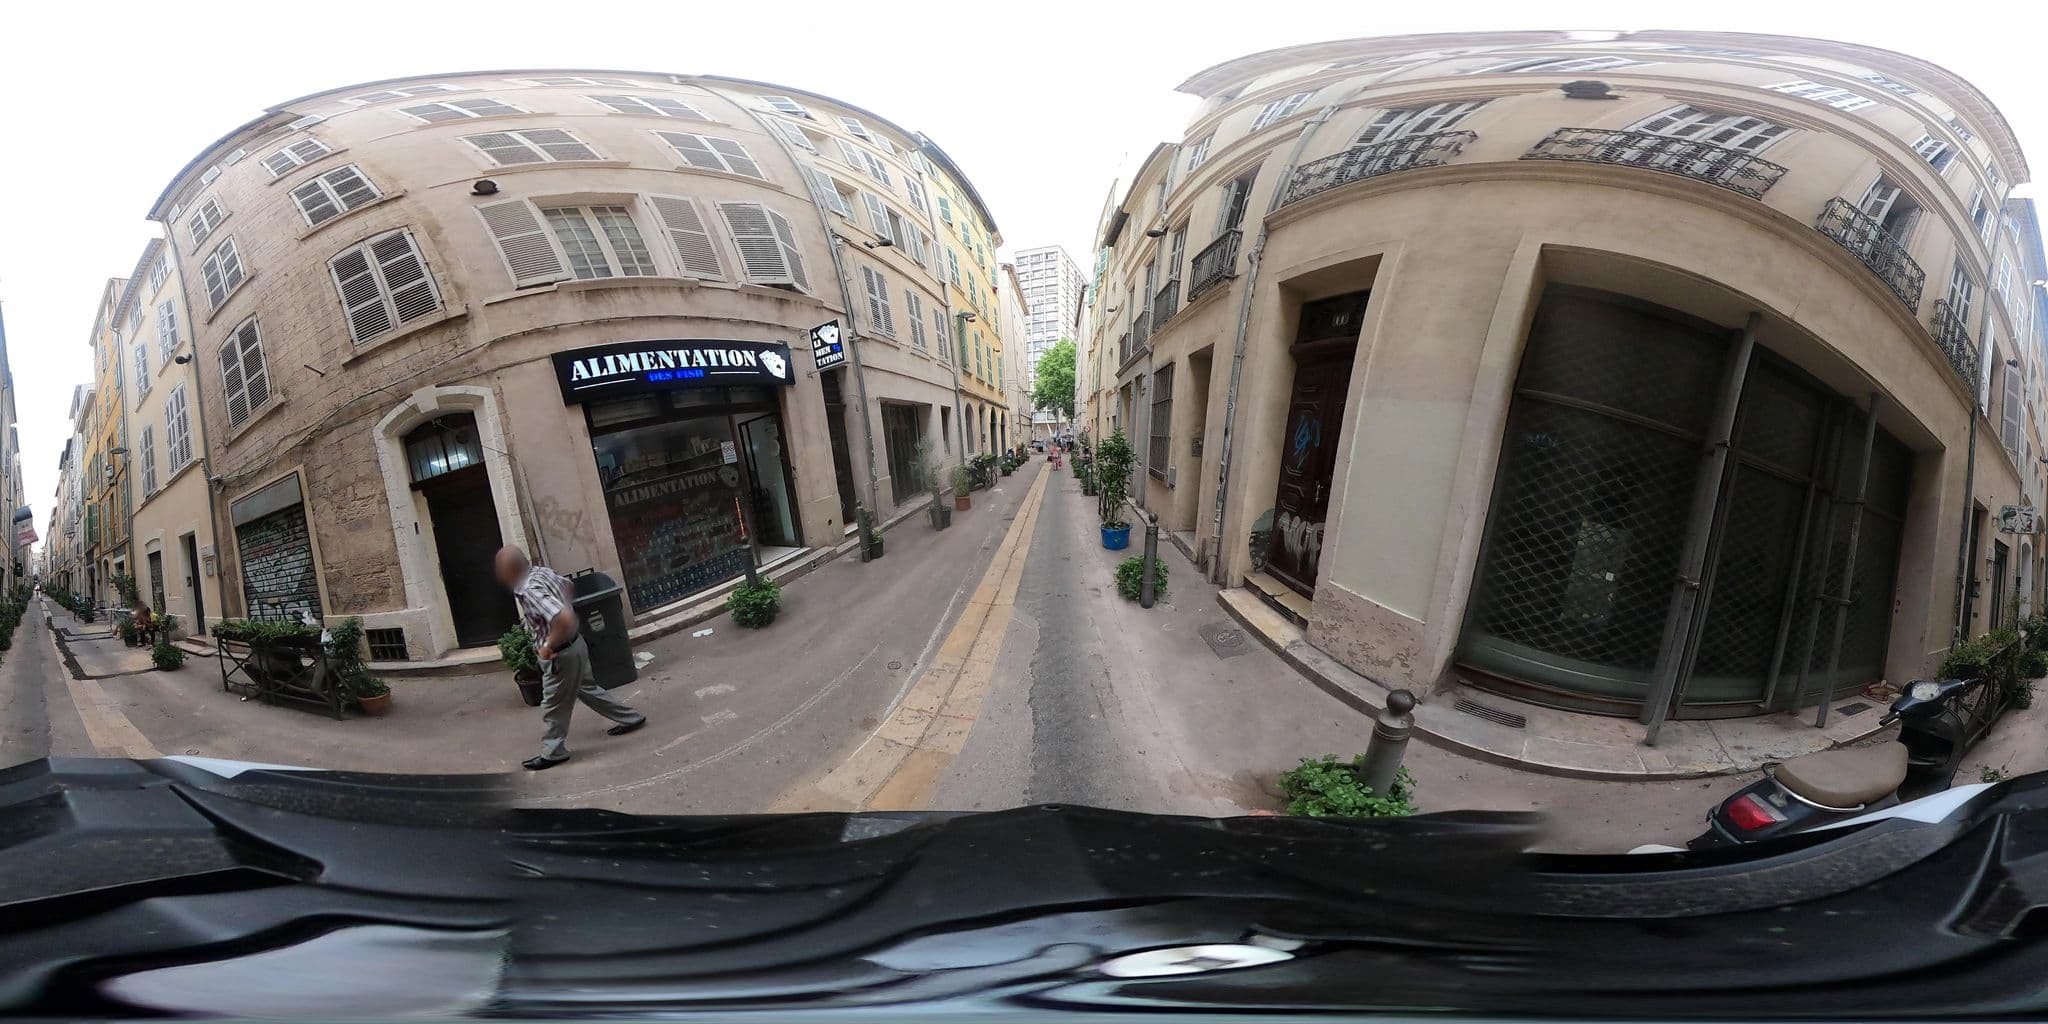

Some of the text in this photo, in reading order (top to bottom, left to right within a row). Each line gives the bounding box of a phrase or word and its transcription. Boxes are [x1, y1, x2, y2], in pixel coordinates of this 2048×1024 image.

[815, 345, 831, 357] MEN
[570, 349, 757, 381] ALIMENTATION
[817, 352, 843, 366] TATION
[648, 371, 673, 382] DES
[614, 471, 718, 506] ALIMENTATION
